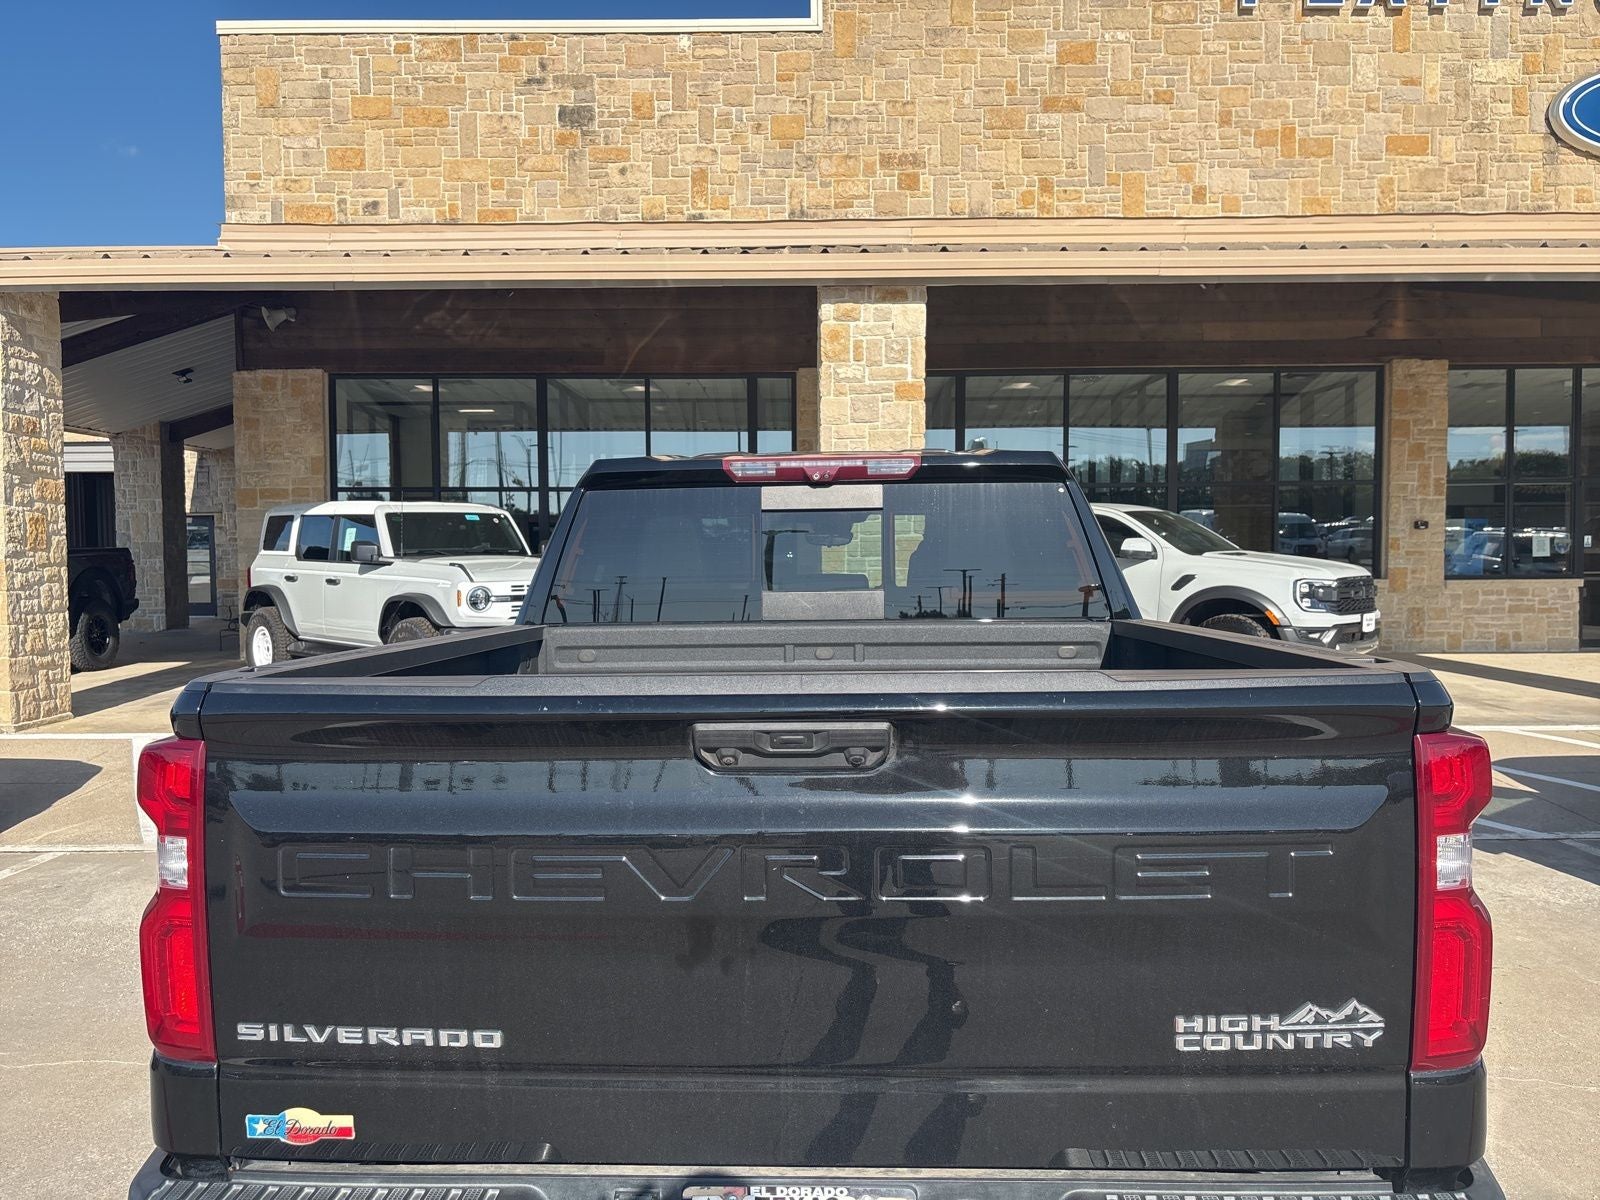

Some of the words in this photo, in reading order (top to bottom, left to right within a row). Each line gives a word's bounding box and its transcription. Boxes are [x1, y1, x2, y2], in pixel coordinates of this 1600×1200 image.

[277, 842, 1334, 902] CHEVROLET
[1175, 1014, 1280, 1033] HIGH
[237, 1022, 503, 1049] SILVERADO
[1175, 1030, 1385, 1052] COUNTRY
[263, 1118, 284, 1135] El
[284, 1118, 338, 1136] Dorado
[749, 1186, 771, 1197] EL
[775, 1186, 849, 1197] DORADO
